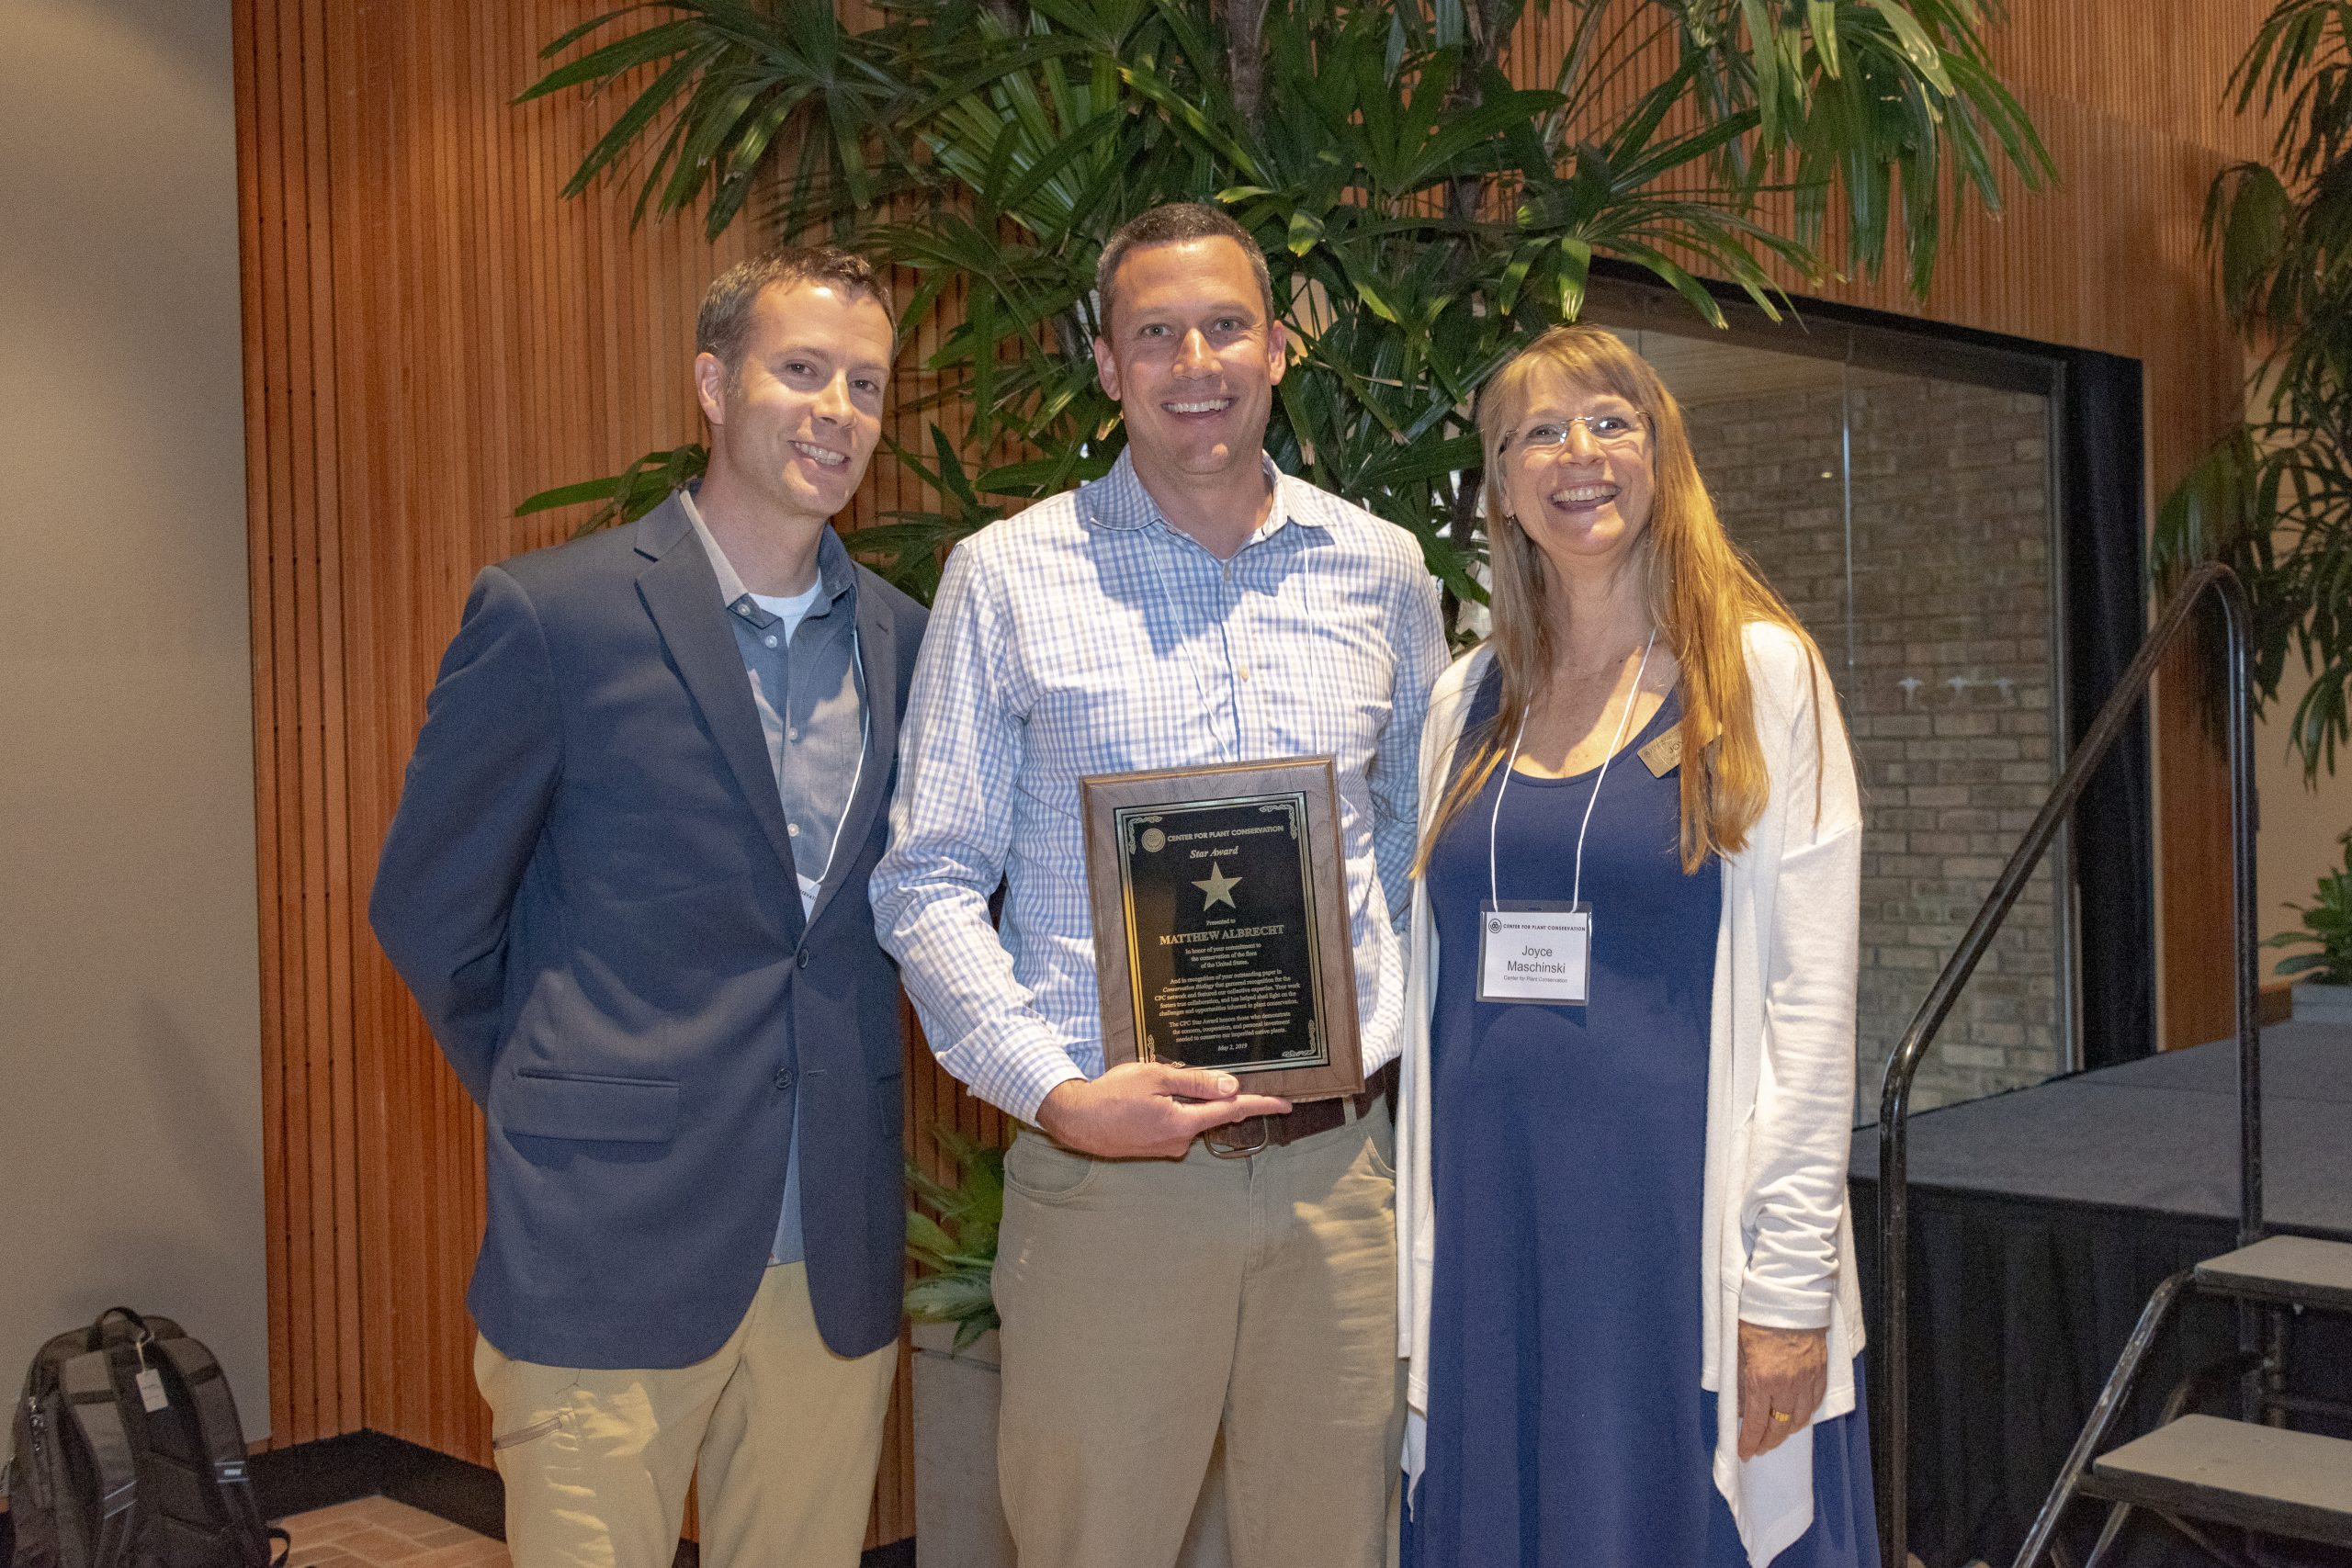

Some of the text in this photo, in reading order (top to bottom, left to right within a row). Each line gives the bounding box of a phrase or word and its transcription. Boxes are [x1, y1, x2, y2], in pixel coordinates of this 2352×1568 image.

[1231, 826, 1284, 836] CONSERVATION
[1189, 846, 1239, 858] Star Award
[1159, 925, 1284, 944] MATTHEW ALBRECHT
[1521, 945, 1553, 958] Joyce
[1507, 961, 1566, 974] Maschinski
[1247, 977, 1274, 986] recognition
[1194, 1005, 1227, 1014] opportunities
[1231, 1030, 1254, 1038] imperiled
